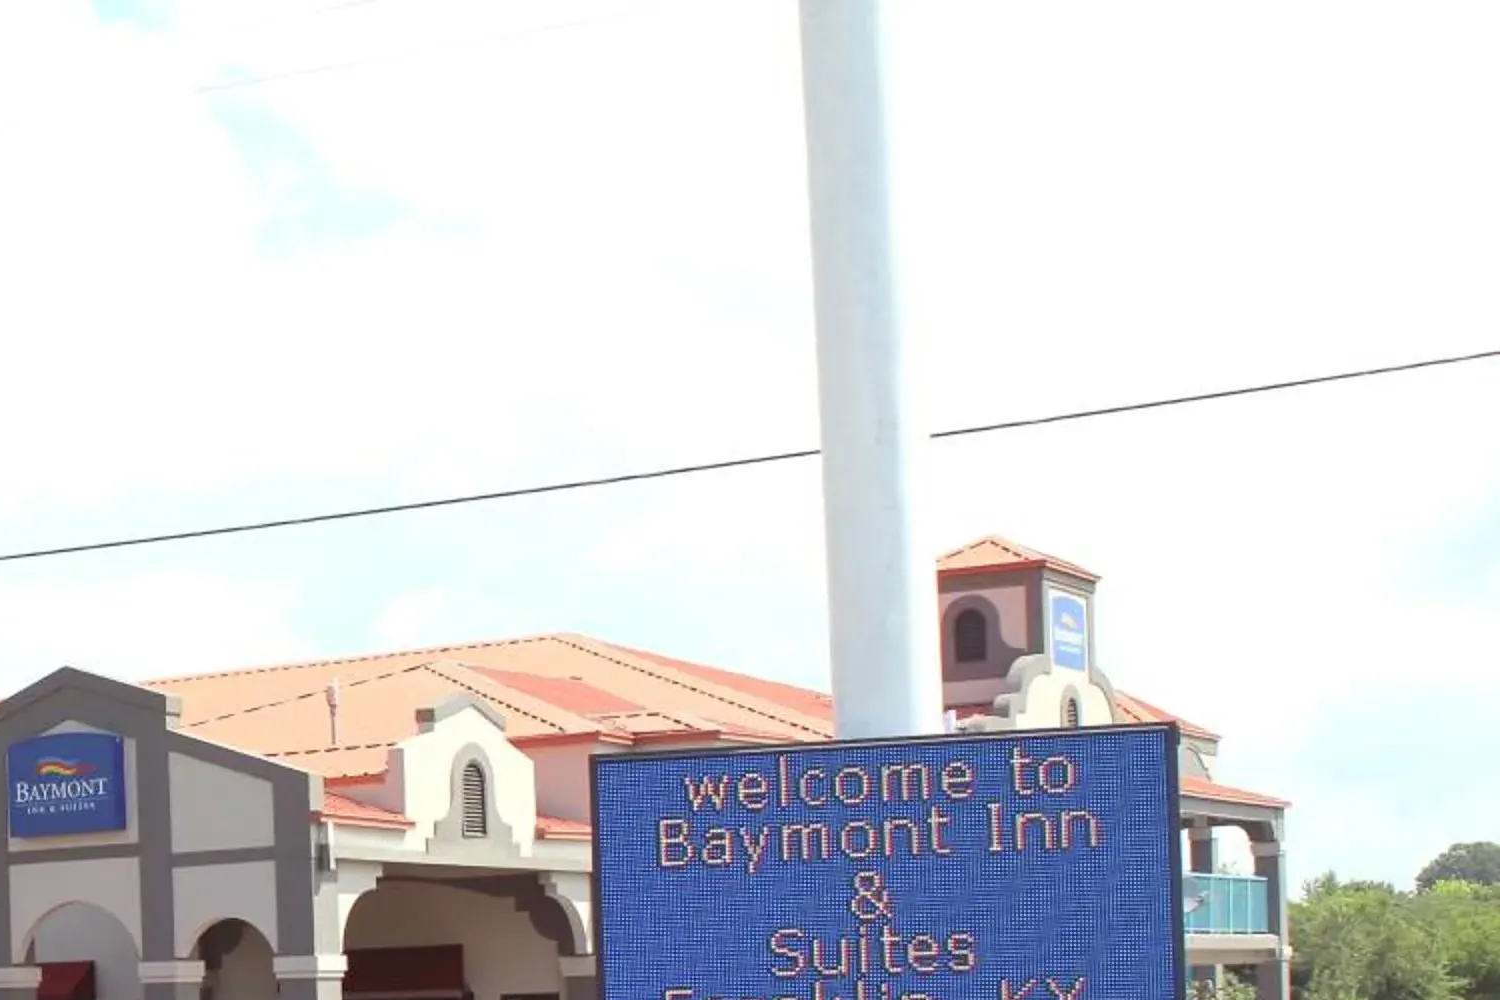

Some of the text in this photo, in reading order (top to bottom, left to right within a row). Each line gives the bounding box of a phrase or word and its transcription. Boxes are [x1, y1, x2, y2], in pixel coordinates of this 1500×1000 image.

[16, 777, 108, 803] BAYMONT
[683, 746, 1078, 812] welcome to
[657, 802, 1101, 874] Baymont Inn
[849, 869, 895, 921] &
[768, 921, 977, 979] Suites
